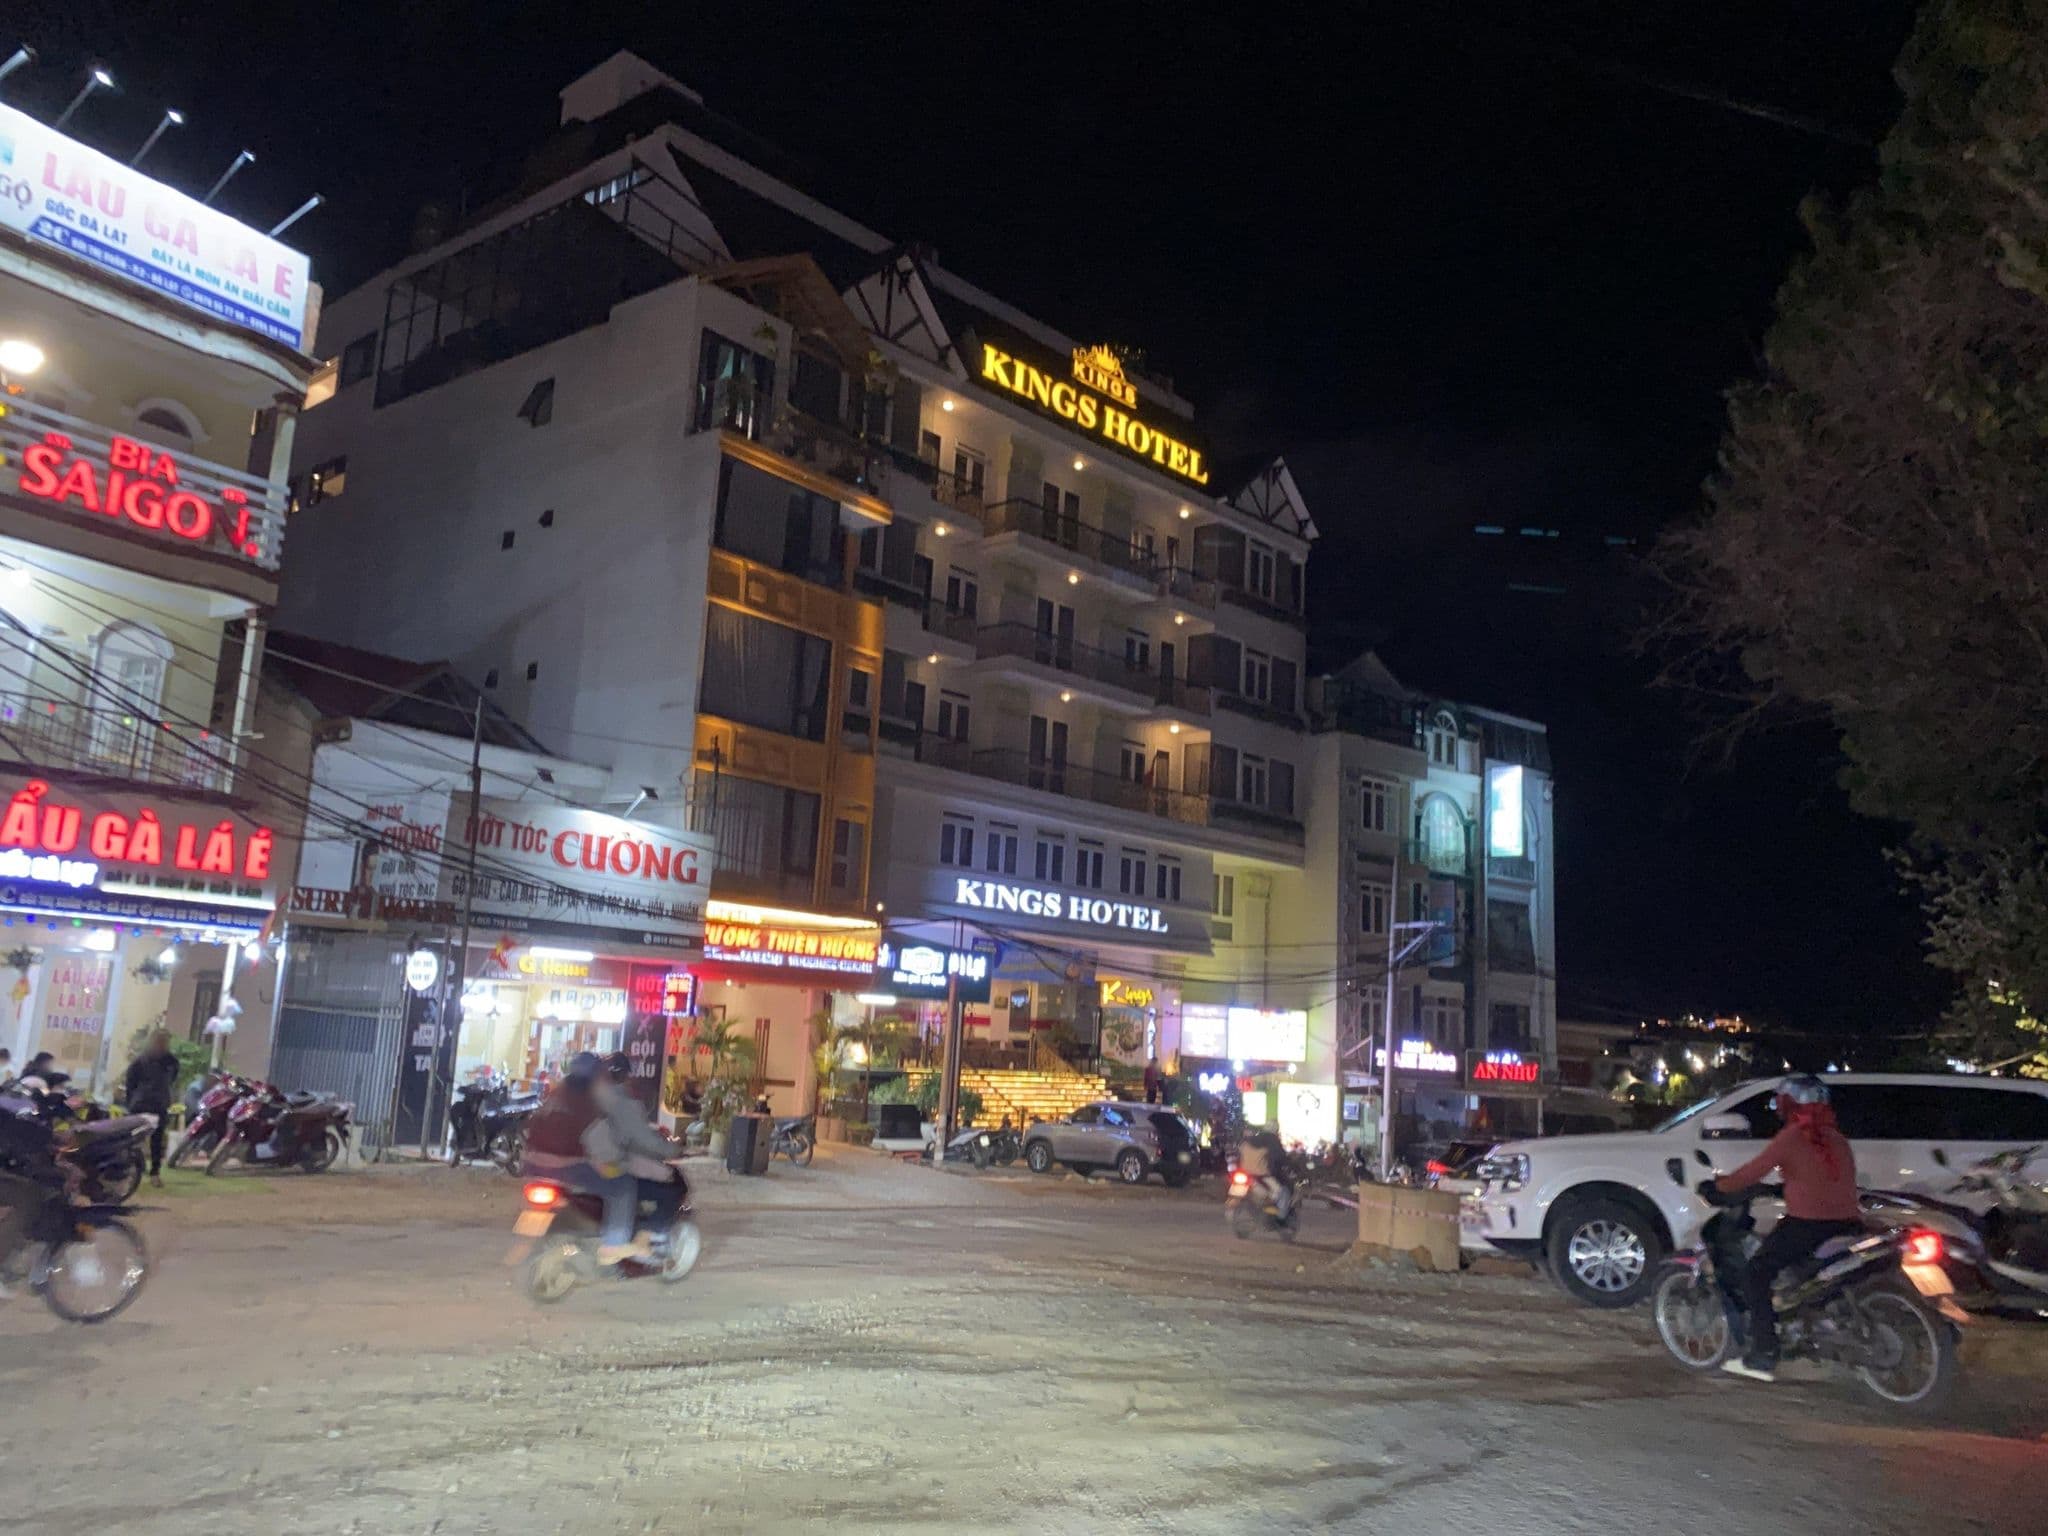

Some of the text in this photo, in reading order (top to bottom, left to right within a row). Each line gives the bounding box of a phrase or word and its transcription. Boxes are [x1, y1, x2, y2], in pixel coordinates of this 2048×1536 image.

[1072, 360, 1136, 407] KINGS
[981, 344, 1209, 485] KINGS HOTEL
[109, 436, 178, 484] BIA
[90, 808, 161, 865] GÀ
[176, 821, 235, 874] LÁ
[511, 820, 548, 853] TÓC
[551, 831, 699, 884] CƯỜNG
[957, 878, 1168, 932] KINGS HOTEL
[1473, 1062, 1499, 1079] AN
